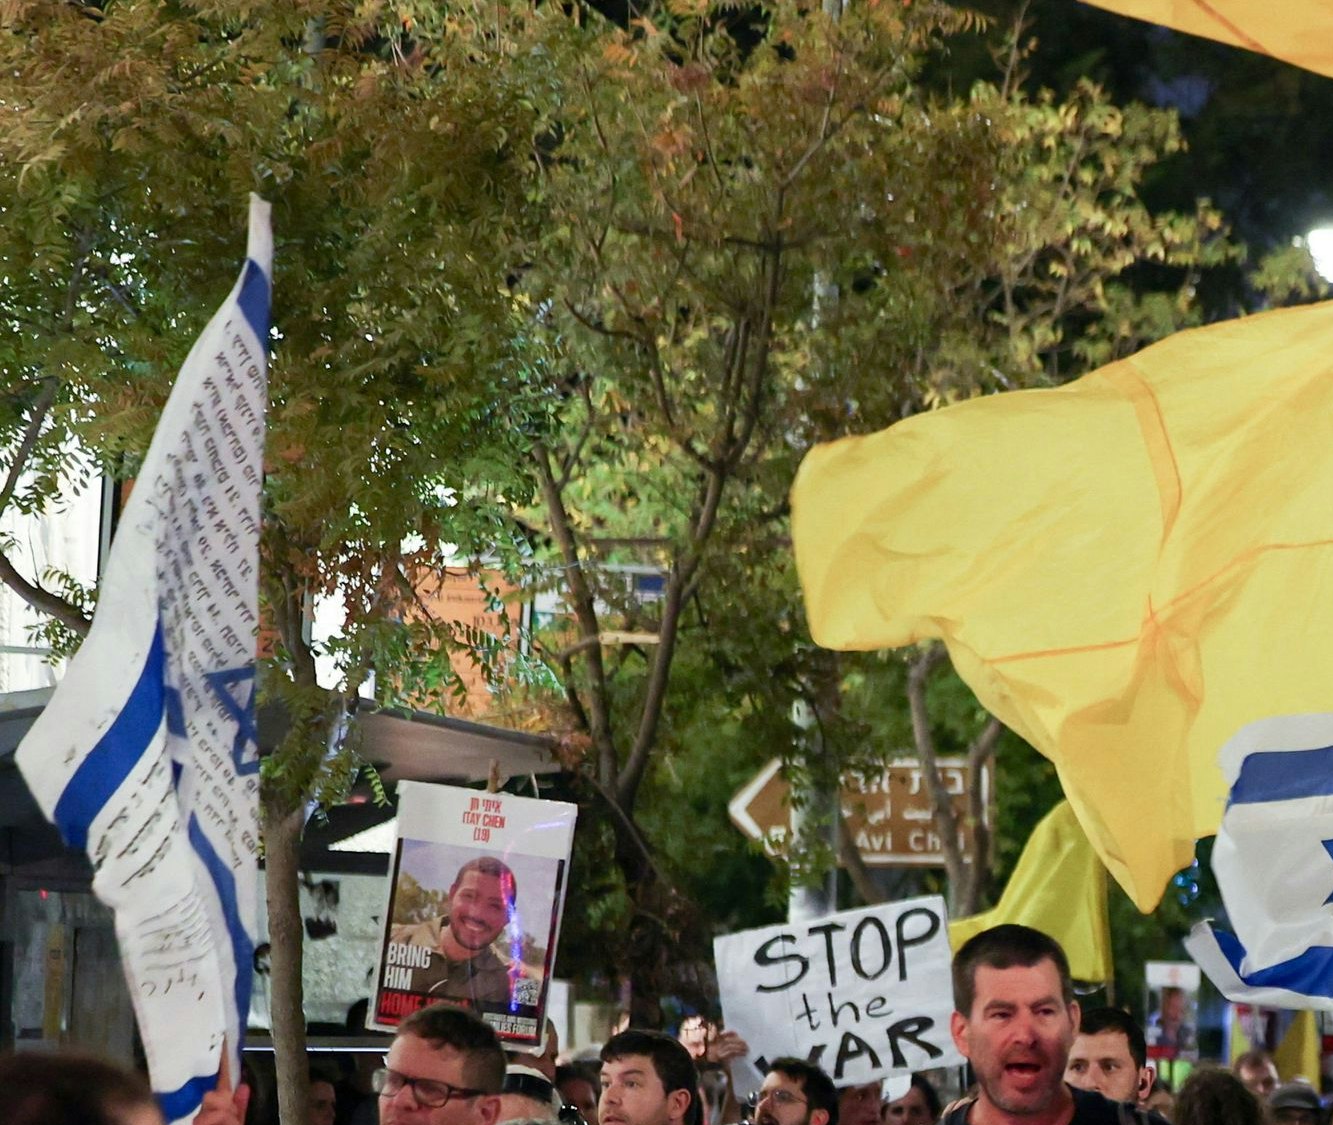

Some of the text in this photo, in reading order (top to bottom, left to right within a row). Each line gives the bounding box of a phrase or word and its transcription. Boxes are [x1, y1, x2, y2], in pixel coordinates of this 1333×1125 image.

[462, 811, 506, 829] ITAY CHEN
[855, 827, 966, 852] Avi Chi
[388, 943, 432, 969] BRING
[754, 908, 940, 993] STOP
[384, 965, 413, 991] HIM
[796, 992, 893, 1031] the
